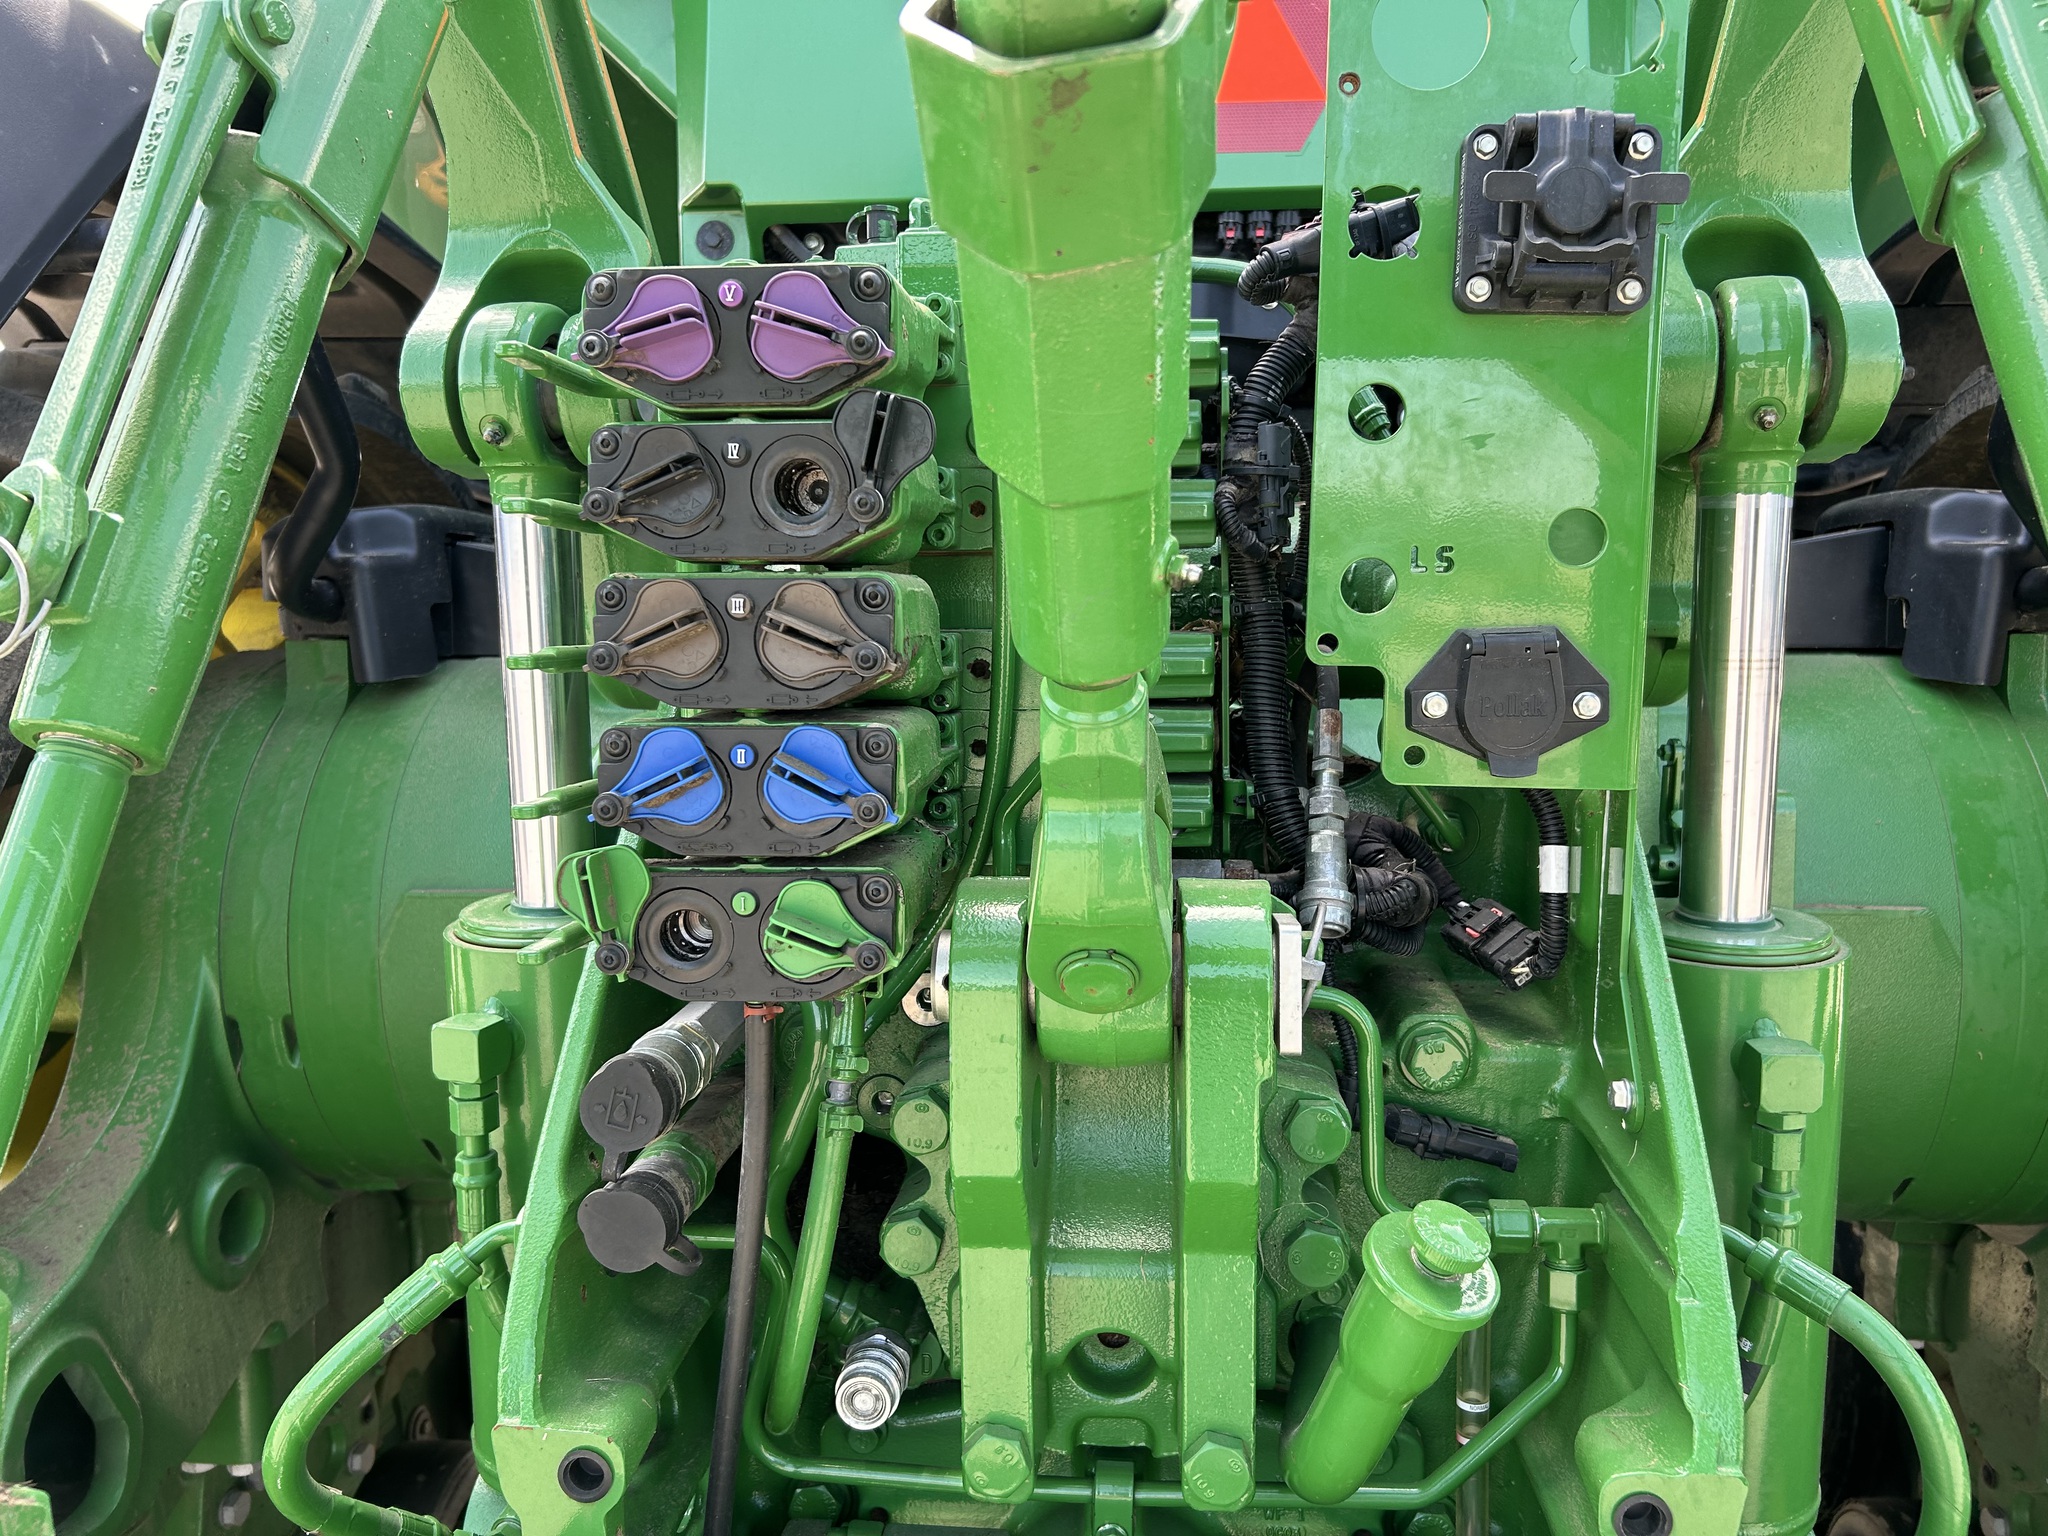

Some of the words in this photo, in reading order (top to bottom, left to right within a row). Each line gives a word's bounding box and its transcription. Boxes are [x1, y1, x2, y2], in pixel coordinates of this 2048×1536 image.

[171, 33, 193, 68] USA
[1466, 220, 1478, 243] ISO
[725, 284, 735, 302] V
[225, 432, 252, 472] USA
[727, 443, 740, 459] IV
[731, 597, 746, 614] III
[1480, 693, 1547, 718] Pollak
[737, 748, 746, 765] II
[907, 1137, 933, 1149] 10.9
[895, 1257, 920, 1271] 10.9
[921, 1353, 933, 1375] D
